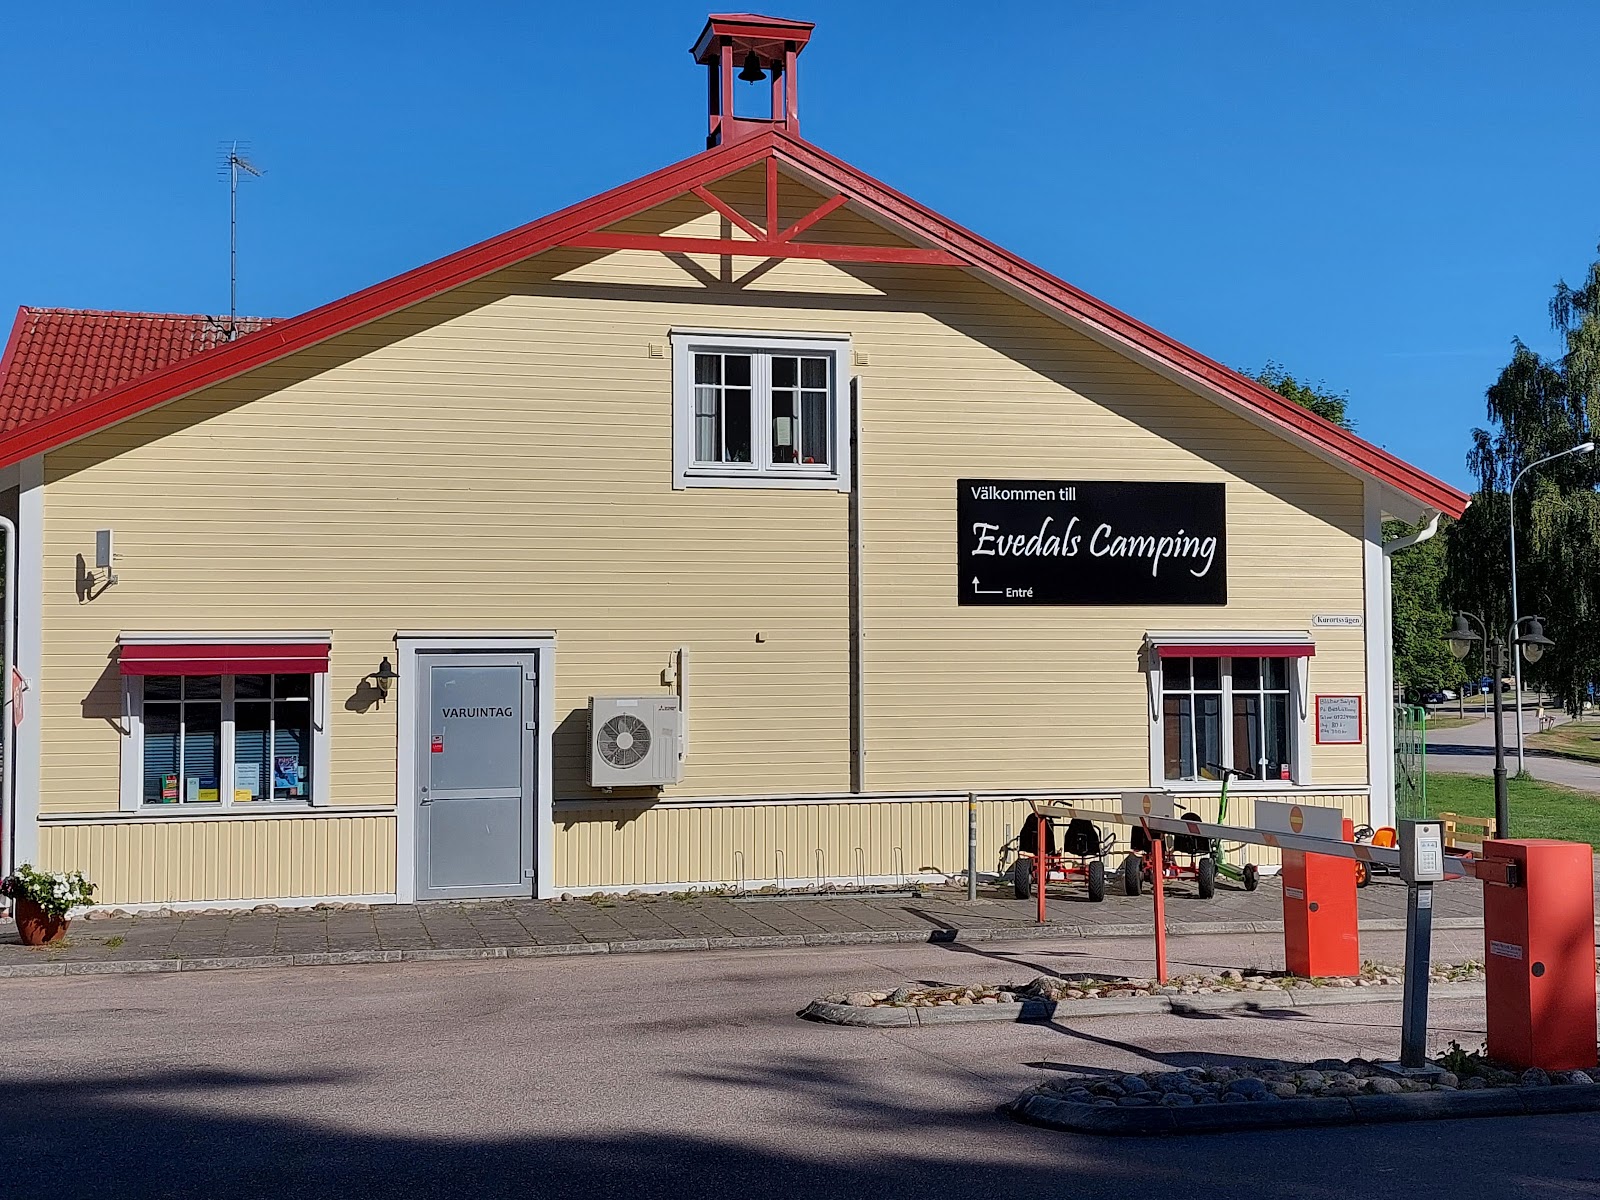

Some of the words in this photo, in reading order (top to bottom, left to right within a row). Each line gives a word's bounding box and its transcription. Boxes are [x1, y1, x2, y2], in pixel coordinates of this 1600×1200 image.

[970, 485, 1055, 500] Välkommen
[1058, 486, 1075, 500] till
[971, 516, 1081, 556] Evedals
[1089, 522, 1216, 577] Camping
[1006, 586, 1033, 597] Entré
[442, 707, 513, 718] VARUINTAG
